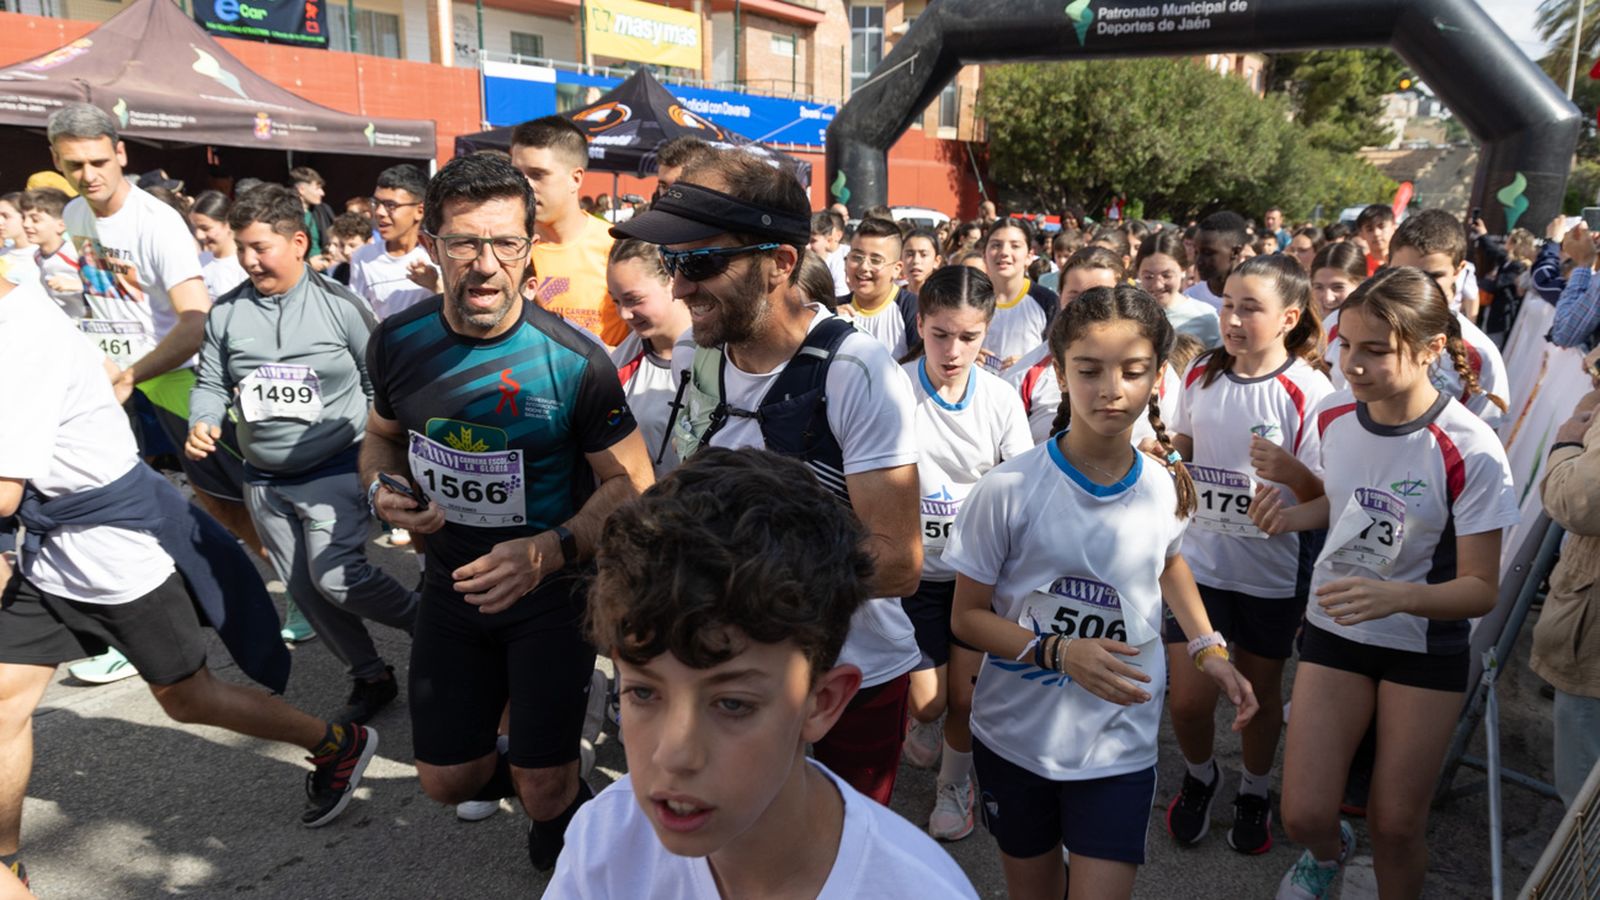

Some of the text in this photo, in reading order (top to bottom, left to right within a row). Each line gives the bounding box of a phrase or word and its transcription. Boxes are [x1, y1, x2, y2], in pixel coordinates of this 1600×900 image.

[1098, 0, 1248, 20] Patronato Municipal de
[614, 13, 697, 47] masymas
[1097, 16, 1211, 35] Deportes de Jaén
[253, 384, 313, 404] 1499
[480, 465, 508, 473] GLORIA
[423, 468, 508, 504] 1566
[1201, 490, 1252, 515] 179
[1360, 516, 1393, 547] 73
[1050, 606, 1127, 643] 506
